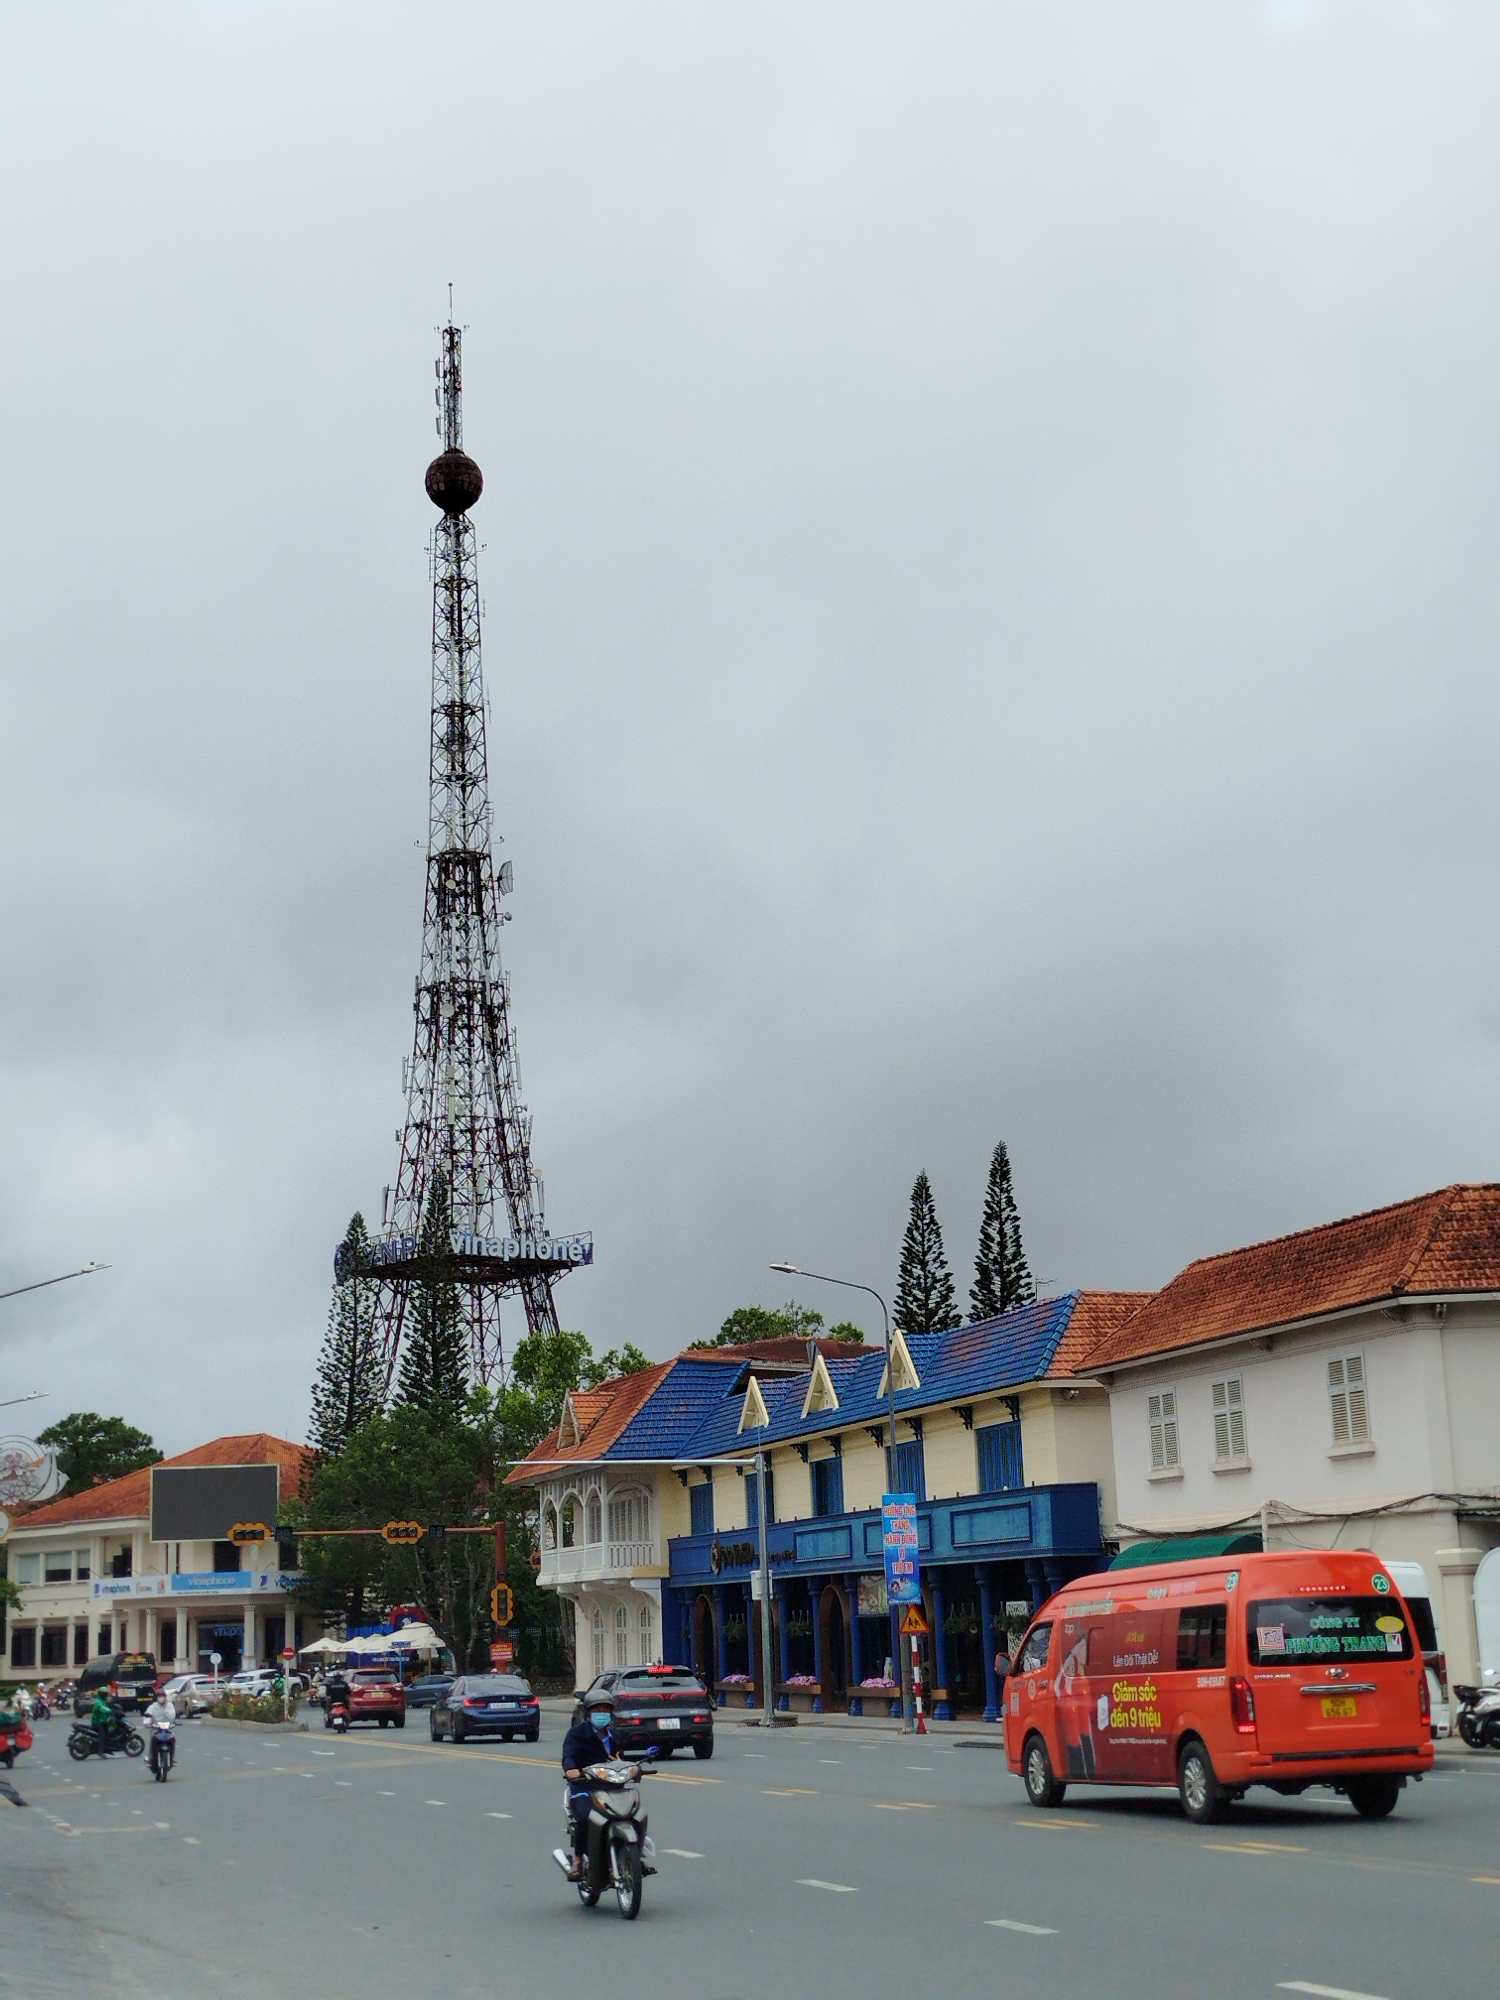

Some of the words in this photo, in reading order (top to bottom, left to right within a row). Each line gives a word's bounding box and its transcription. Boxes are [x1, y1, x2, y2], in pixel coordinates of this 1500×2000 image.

[450, 1230, 583, 1262] vinaphone
[101, 1583, 131, 1595] vinaphone
[188, 1576, 236, 1587] vinaphone
[1374, 1578, 1388, 1590] 23
[1309, 1615, 1343, 1629] CÔNG
[1345, 1617, 1360, 1628] TY
[1285, 1635, 1340, 1654] PHƯƠNG
[1341, 1635, 1386, 1652] TRANG
[1112, 1680, 1138, 1702] Giảm
[1138, 1676, 1157, 1702] sốc
[1110, 1703, 1129, 1728] đến
[1129, 1707, 1138, 1728] 9
[1138, 1706, 1161, 1733] triệu
